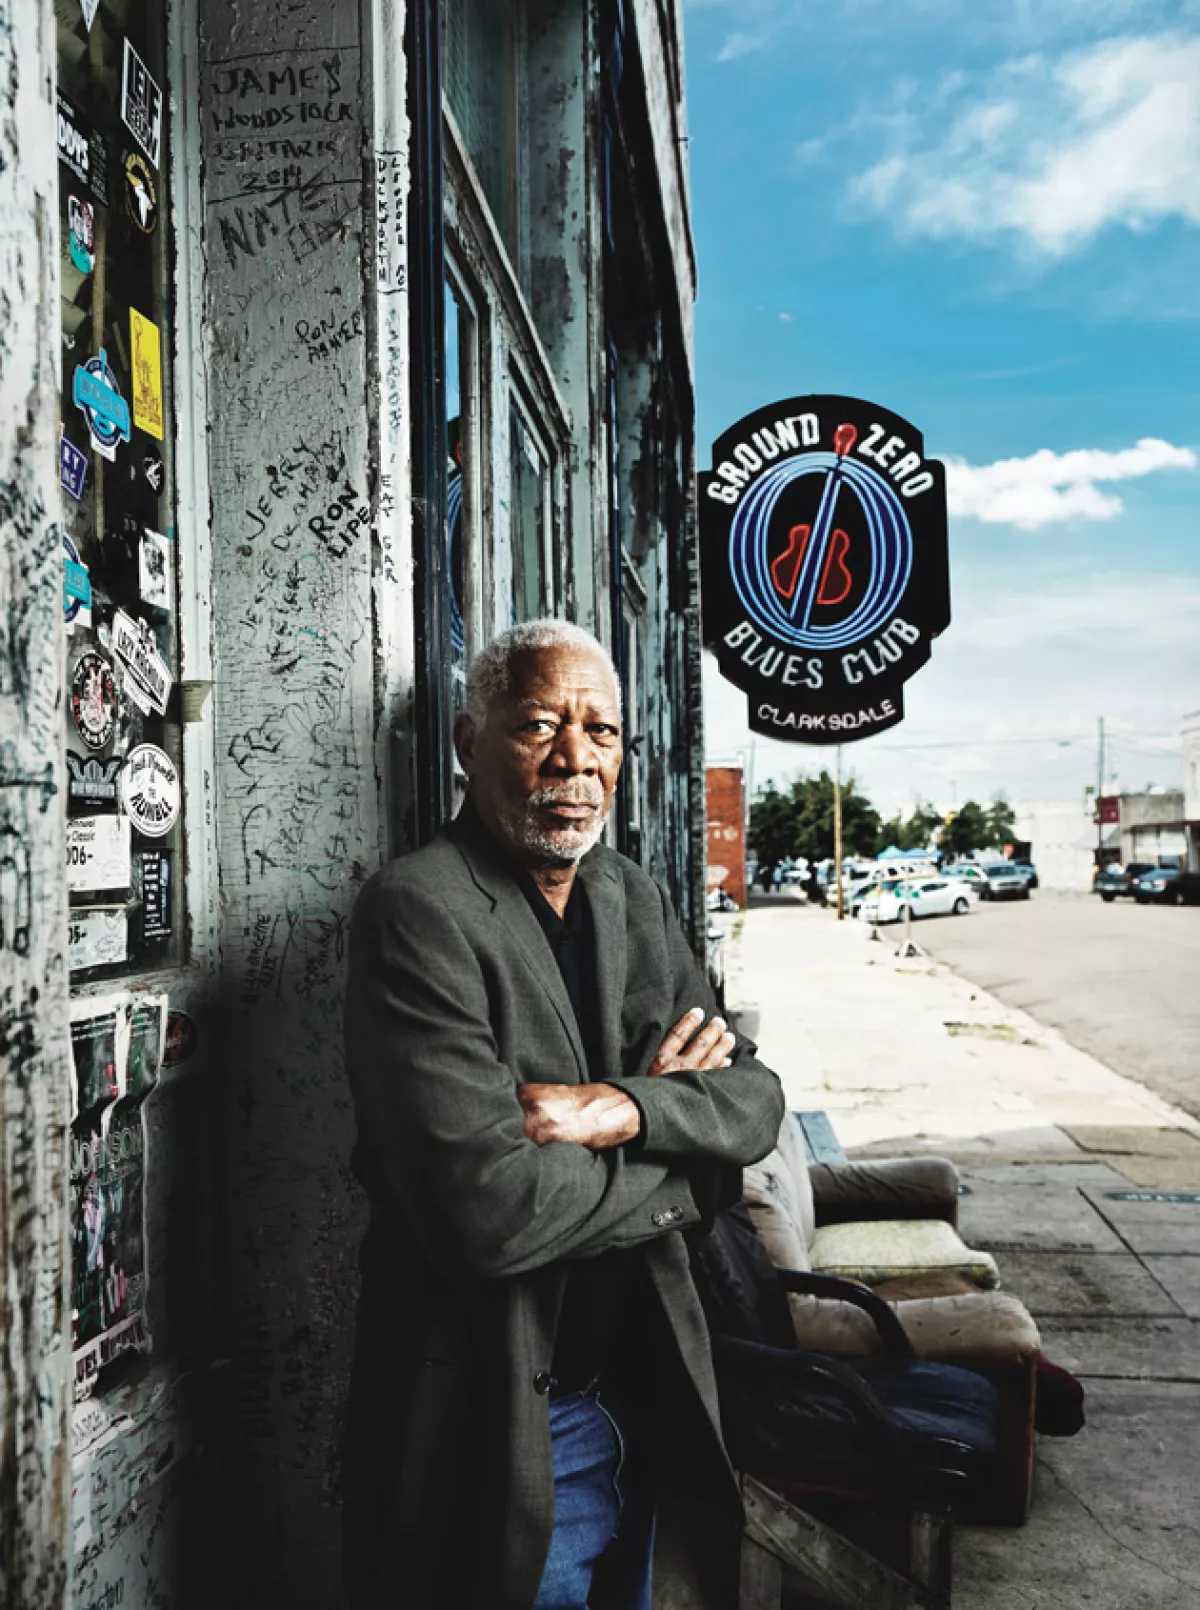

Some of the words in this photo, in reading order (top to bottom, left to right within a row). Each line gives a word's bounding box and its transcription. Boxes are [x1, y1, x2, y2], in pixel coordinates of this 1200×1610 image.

[211, 55, 341, 100] JAMES
[706, 412, 820, 506] GROUND
[857, 422, 936, 499] ZERO
[309, 480, 359, 542] RON
[327, 507, 370, 559] LIPE
[723, 620, 824, 689] BLUES
[841, 617, 922, 685] CLUB
[757, 699, 897, 731] CLARKSDALE
